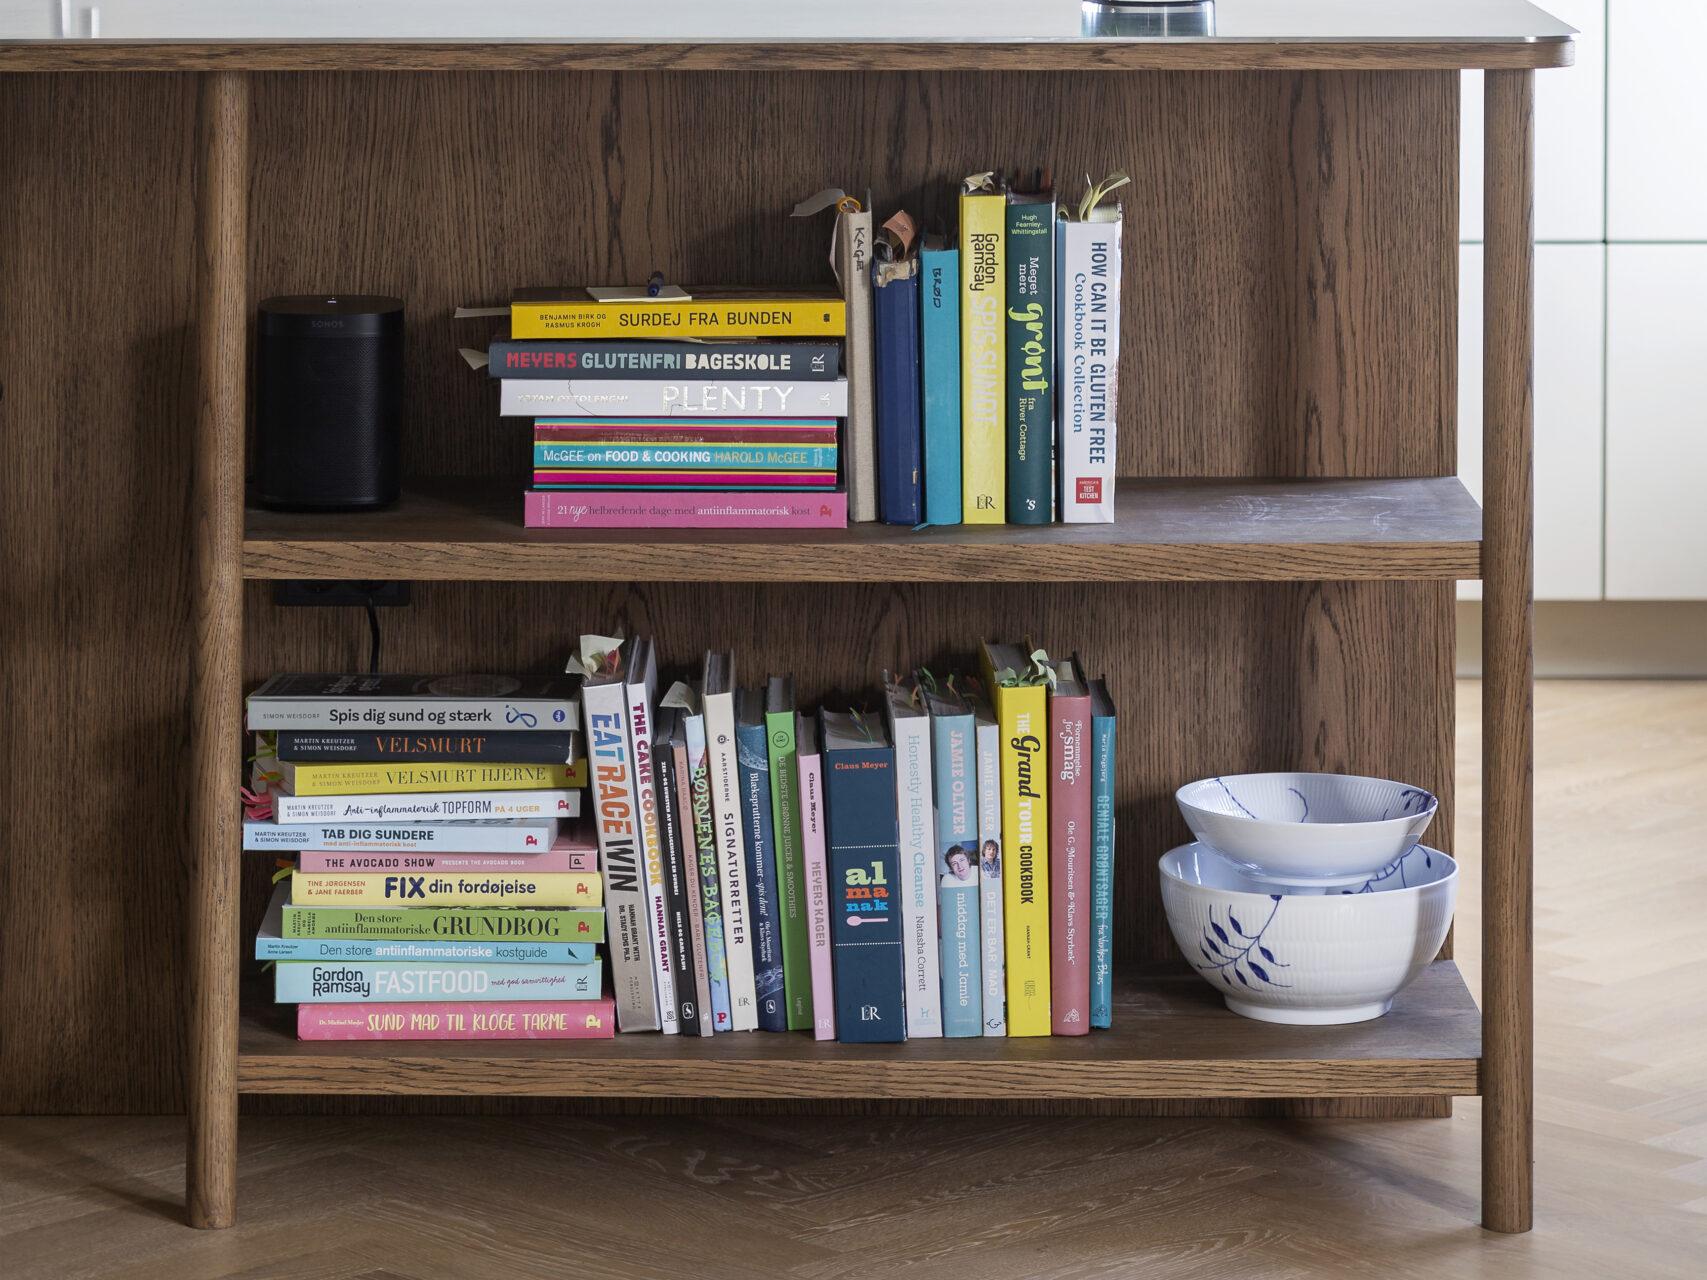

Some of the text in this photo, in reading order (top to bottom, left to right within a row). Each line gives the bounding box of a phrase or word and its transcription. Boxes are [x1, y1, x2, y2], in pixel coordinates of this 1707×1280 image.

[970, 233, 984, 291] Ramsay
[985, 233, 999, 284] Gordon
[1091, 242, 1107, 277] HOW
[1019, 264, 1027, 294] mere
[1028, 256, 1039, 295] Meget
[1091, 282, 1107, 312] CAN
[619, 312, 792, 327] SURDEJ FRA BUNDEN
[1091, 319, 1107, 333] IT
[1008, 302, 1049, 396] grønt
[1073, 273, 1087, 433] Cookbook Collection
[1090, 338, 1106, 356] BE
[506, 352, 791, 371] MEYERS GLUTENFRI BAGESKOLE
[971, 296, 997, 427] SPIS SUNDT
[663, 384, 794, 412] PLENTY
[1028, 397, 1036, 410] fra
[1090, 363, 1106, 421] GLUTEN
[1018, 398, 1028, 461] River Cottage
[543, 450, 584, 462] McGEE
[587, 453, 601, 462] on
[605, 451, 639, 462] FOOD
[642, 451, 651, 462] &
[654, 451, 711, 463] COOKING
[714, 451, 764, 463] HAROLD
[767, 451, 808, 464] McGEE
[1089, 428, 1106, 464] FREE
[569, 505, 589, 522] nye
[589, 505, 648, 515] helbredende
[649, 505, 672, 518] dage
[674, 505, 695, 515] med
[697, 505, 790, 516] antiinflammatorisk
[791, 505, 810, 516] kost
[329, 708, 492, 725] Spis dig sund og stærk
[376, 736, 486, 753] VELSMURT
[1060, 719, 1074, 785] for smag
[1074, 720, 1082, 777] Fornemmelse
[386, 767, 546, 785] VELSMURT HJERNE
[720, 752, 730, 803] AARSTIDERNE
[835, 762, 888, 770] Claus Meyer
[633, 702, 663, 885] THE CAKE COOKBOOK
[950, 730, 966, 835] JAMIE OLIVER
[442, 800, 492, 815] TOPFORM
[591, 713, 638, 892] EAT RACE WIN
[1010, 712, 1041, 905] THE Grand TOUR COOKBOOK
[693, 763, 718, 877] BØRNENES
[908, 735, 925, 908] Honestly Healthy Cleanse
[1067, 821, 1076, 835] Ole
[321, 829, 434, 841] TAB DIG SUNDERE
[1067, 836, 1075, 845] G.
[325, 858, 435, 868] THE AVOCADO SHOW
[845, 861, 887, 886] al
[1066, 847, 1076, 890] Mouritsen
[385, 877, 536, 898] FIX din fordøjelse
[724, 813, 744, 944] SIGNATURRETTER
[846, 886, 889, 899] ma
[355, 912, 402, 923] Den store
[655, 895, 666, 938] HANNAH
[811, 861, 825, 947] MEYERS KAGER
[846, 899, 888, 912] nak
[1067, 901, 1075, 926] Klavs
[324, 923, 431, 935] antiinflammatoriske
[433, 916, 560, 936] GRUNDBOG
[320, 944, 548, 961] Den store antiinflammatoriske kostguide
[659, 939, 670, 973] GRANT
[916, 915, 926, 992] Natasha Corrett
[956, 893, 970, 1007] middag med Jamie
[1066, 928, 1075, 965] Styrbæk
[313, 967, 364, 982] Gordon
[375, 970, 488, 994] FASTFOOD
[313, 982, 370, 998] Ramsay
[367, 1013, 568, 1032] SUND MAD TIL KLOGE TARME
